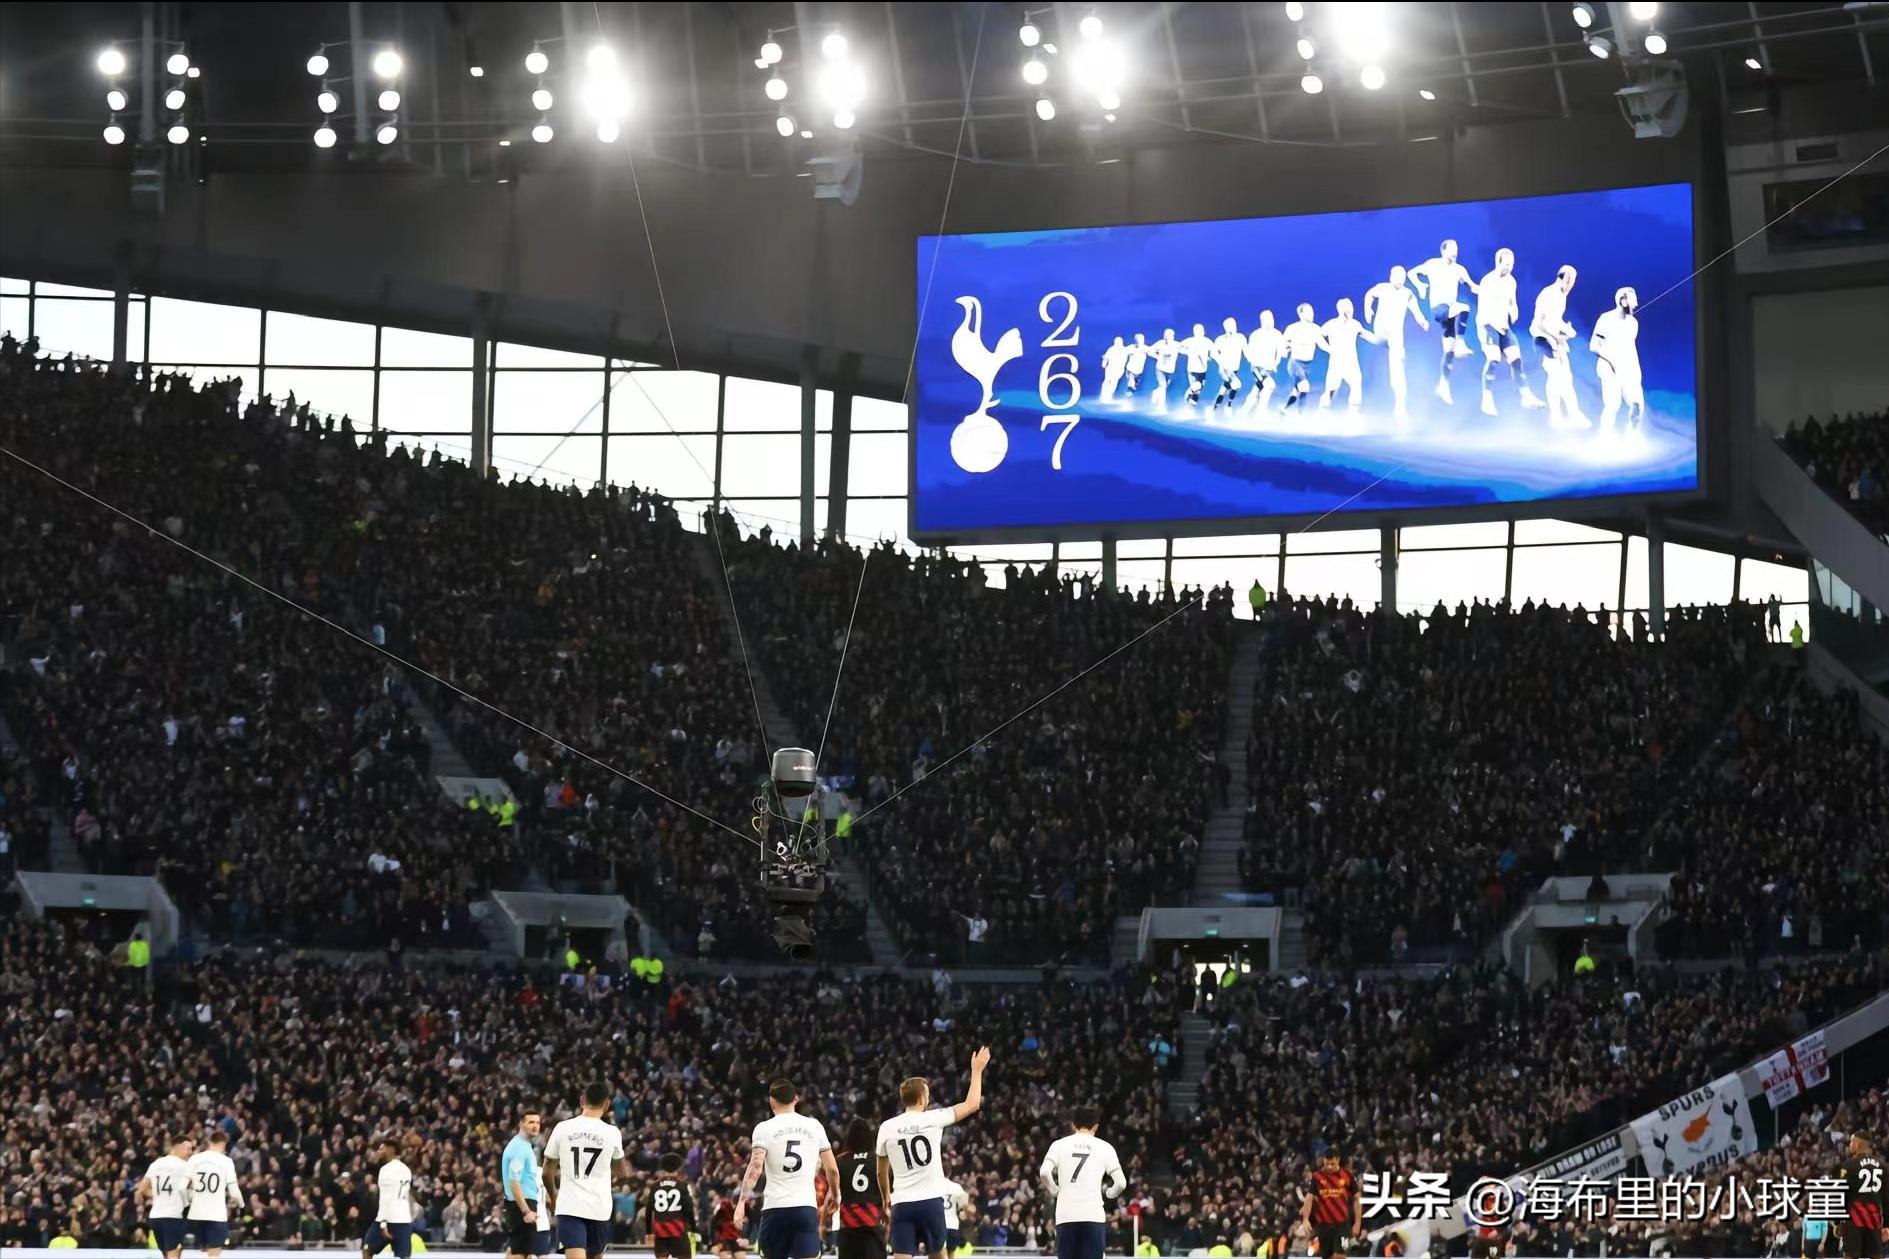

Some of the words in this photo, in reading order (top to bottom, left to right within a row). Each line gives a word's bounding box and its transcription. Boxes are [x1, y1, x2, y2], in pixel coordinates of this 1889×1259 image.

[1658, 1086, 1715, 1121] SPURS
[567, 1132, 604, 1146] ROMERO
[897, 1135, 932, 1171] 10
[570, 1147, 603, 1179] 17
[782, 1140, 802, 1173] 5
[1070, 1153, 1090, 1183] 7
[156, 1175, 173, 1196] 14
[195, 1172, 220, 1193] 30
[852, 1163, 869, 1193] 6
[1858, 1168, 1883, 1193] 25
[654, 1188, 682, 1213] 82
